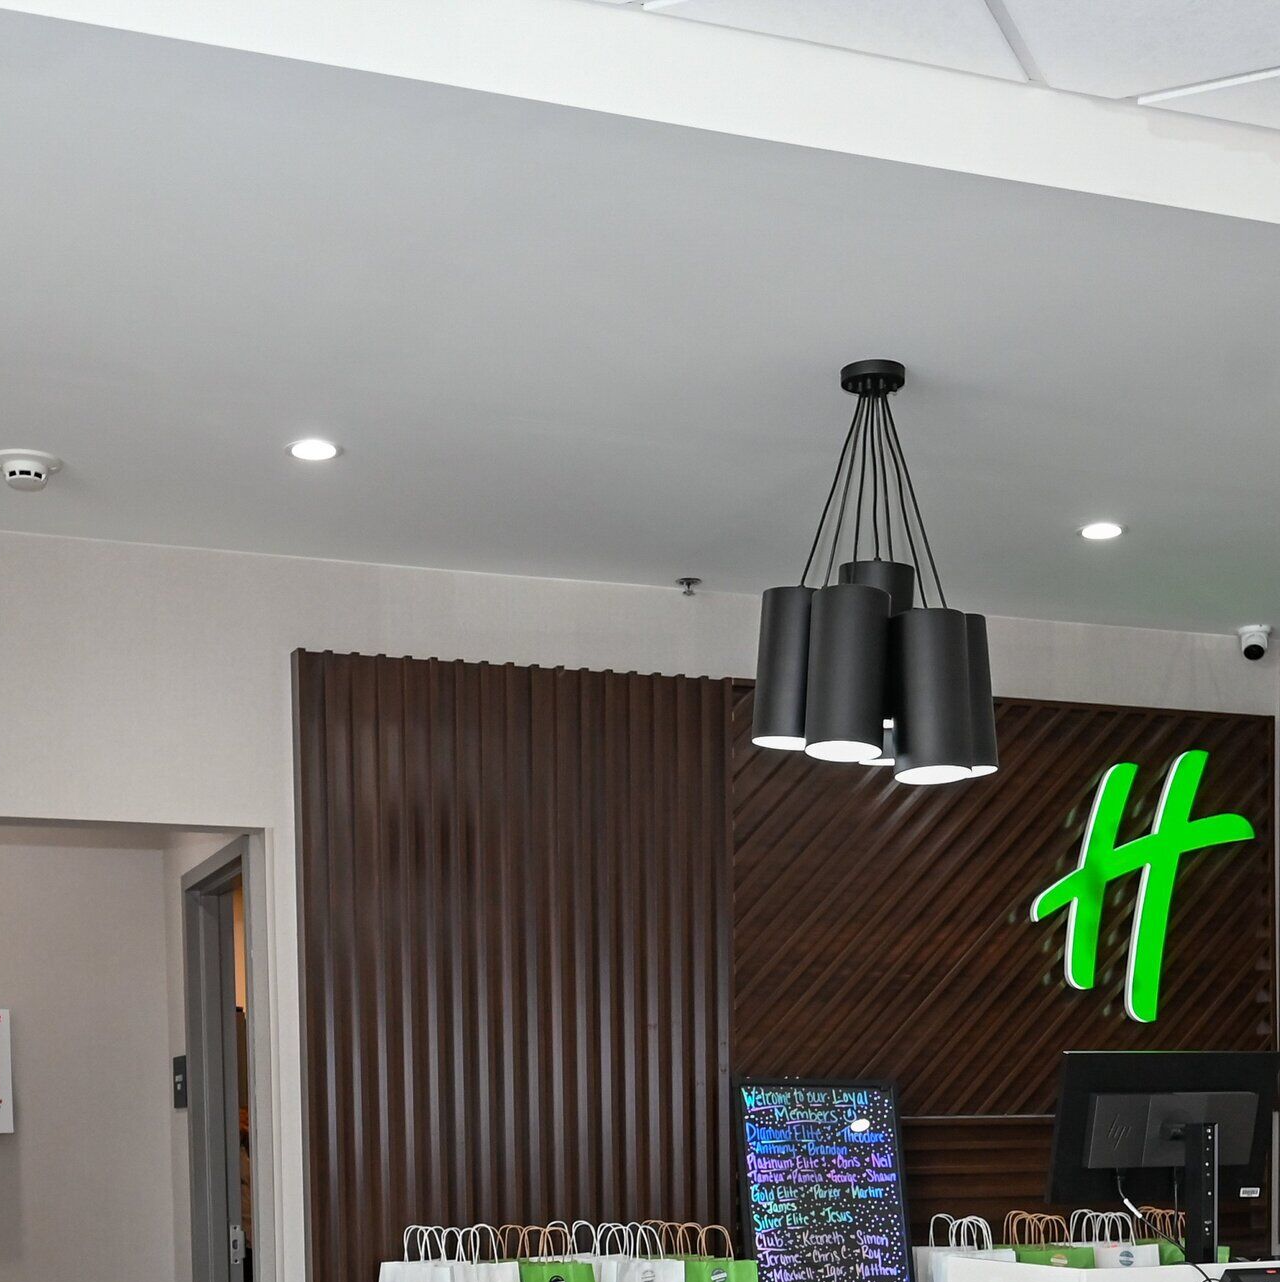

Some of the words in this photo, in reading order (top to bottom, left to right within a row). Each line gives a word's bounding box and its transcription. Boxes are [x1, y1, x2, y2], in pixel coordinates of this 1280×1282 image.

[741, 1087, 791, 1107] Welcome
[793, 1088, 804, 1103] to
[807, 1091, 827, 1103] our
[832, 1089, 869, 1109] Loyal
[774, 1108, 839, 1122] Members
[745, 1122, 792, 1142] Diamond
[794, 1124, 823, 1142] Elite
[839, 1126, 885, 1143] Theodore
[755, 1143, 796, 1157] Anthony
[807, 1143, 848, 1156] Brandon
[746, 1154, 793, 1170] Platinum
[796, 1155, 819, 1168] Elite
[871, 1153, 892, 1168] Neil
[865, 1169, 897, 1182] Shawn
[751, 1184, 775, 1202] Gold
[777, 1186, 799, 1199] Elite
[766, 1201, 797, 1213] James
[753, 1213, 784, 1231] Silver
[786, 1212, 810, 1226] Elite
[824, 1206, 853, 1223] Jesus
[755, 1232, 784, 1248] Club
[856, 1229, 889, 1247] Simon
[761, 1250, 802, 1267] Jerome
[812, 1250, 841, 1264] Chris
[862, 1245, 882, 1265] Roy
[855, 1263, 897, 1280] Matthew
